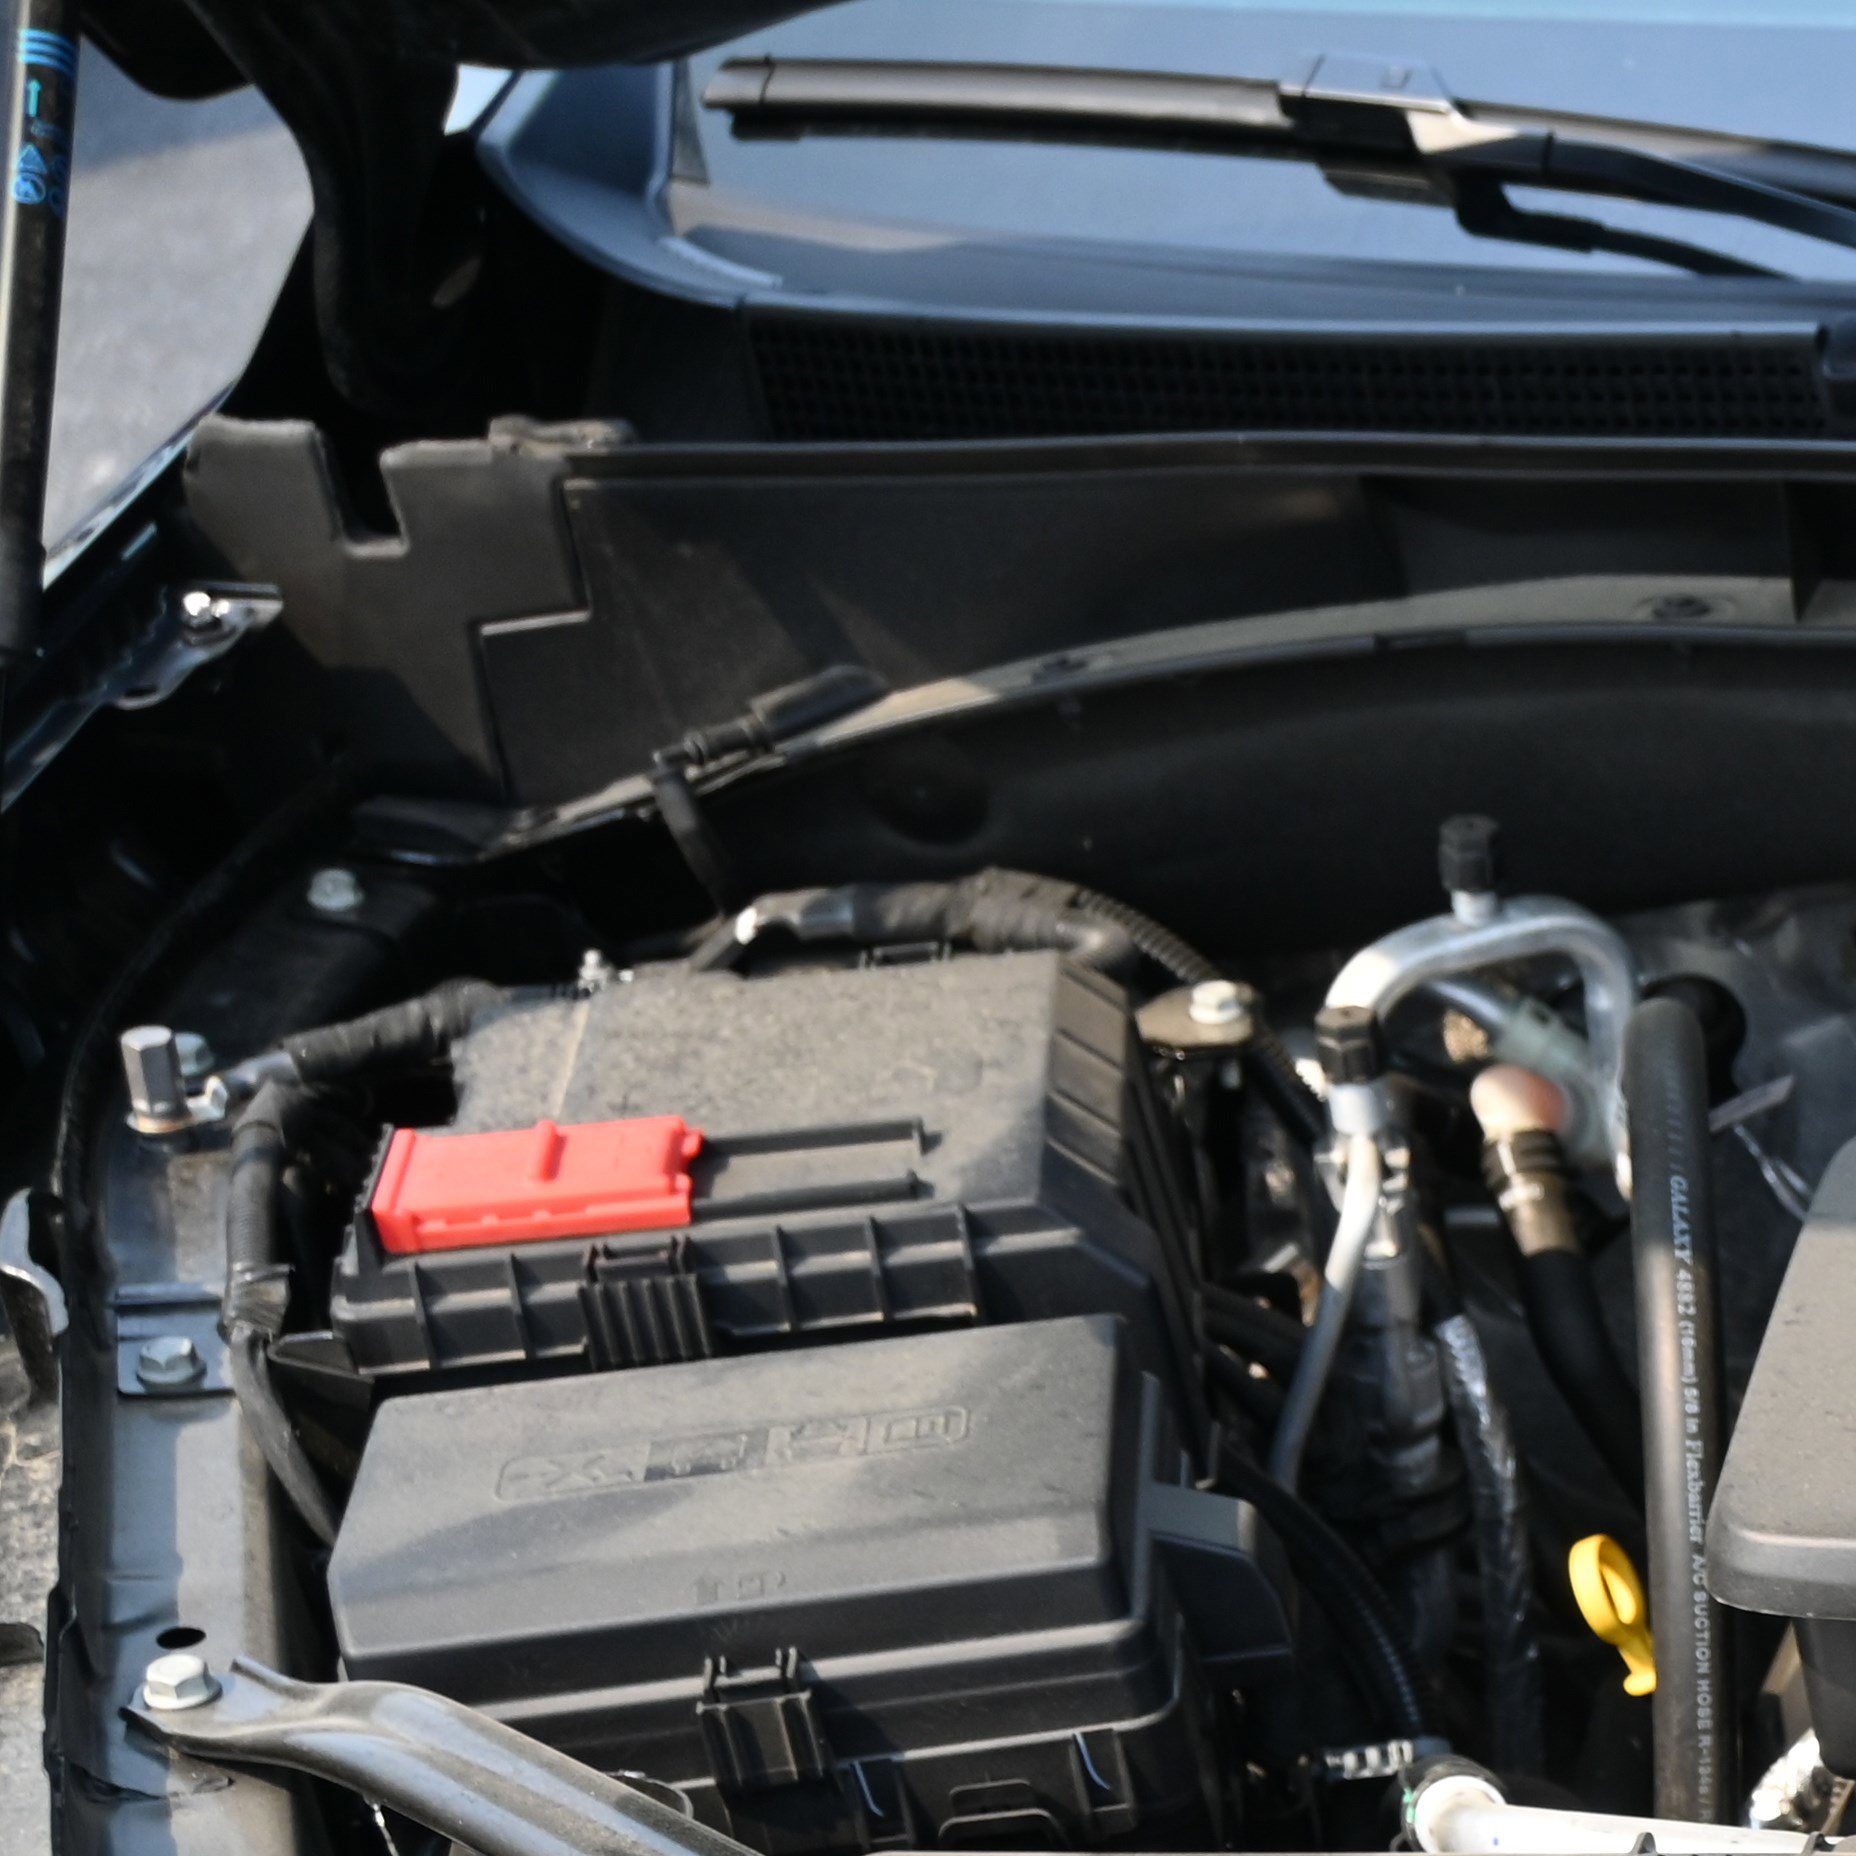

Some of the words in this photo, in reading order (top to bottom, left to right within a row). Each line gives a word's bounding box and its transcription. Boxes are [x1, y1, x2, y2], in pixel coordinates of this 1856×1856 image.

[1671, 1175, 1692, 1265] GALAXY
[1685, 1439, 1706, 1544] Flexbarrier
[1693, 1590, 1711, 1673] SUCTION
